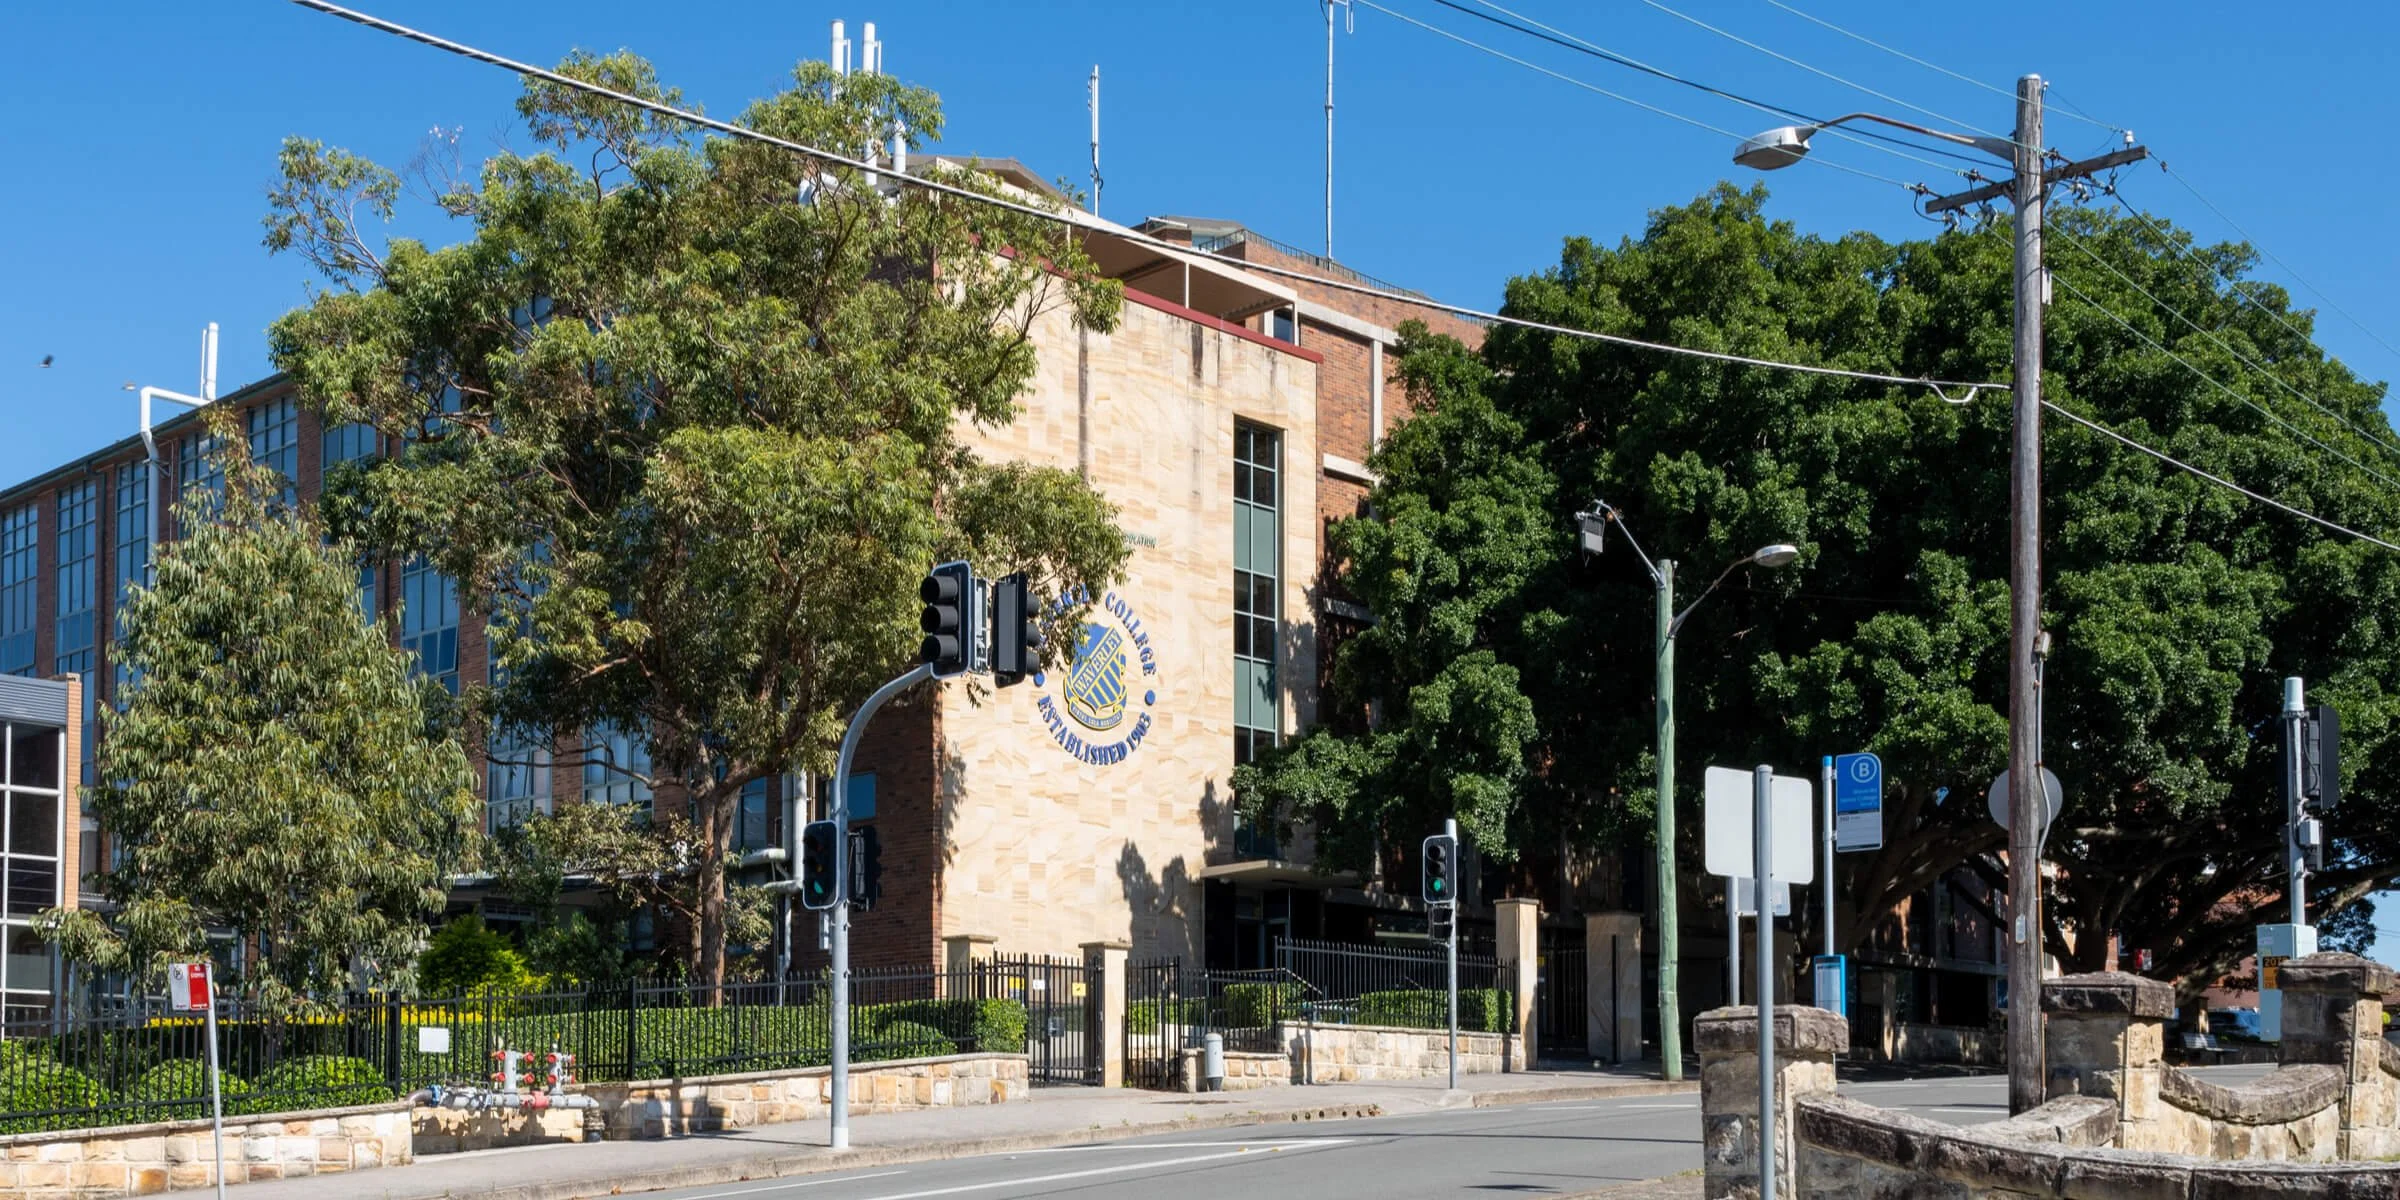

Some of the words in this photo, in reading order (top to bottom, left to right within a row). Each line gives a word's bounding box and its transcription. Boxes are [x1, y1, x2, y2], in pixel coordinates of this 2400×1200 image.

[1074, 631, 1122, 694] WAVERLEY
[1105, 592, 1157, 677] COLLEGE
[1038, 695, 1127, 766] ESTABLISHED
[1126, 712, 1151, 753] 1903
[1859, 762, 1870, 777] B
